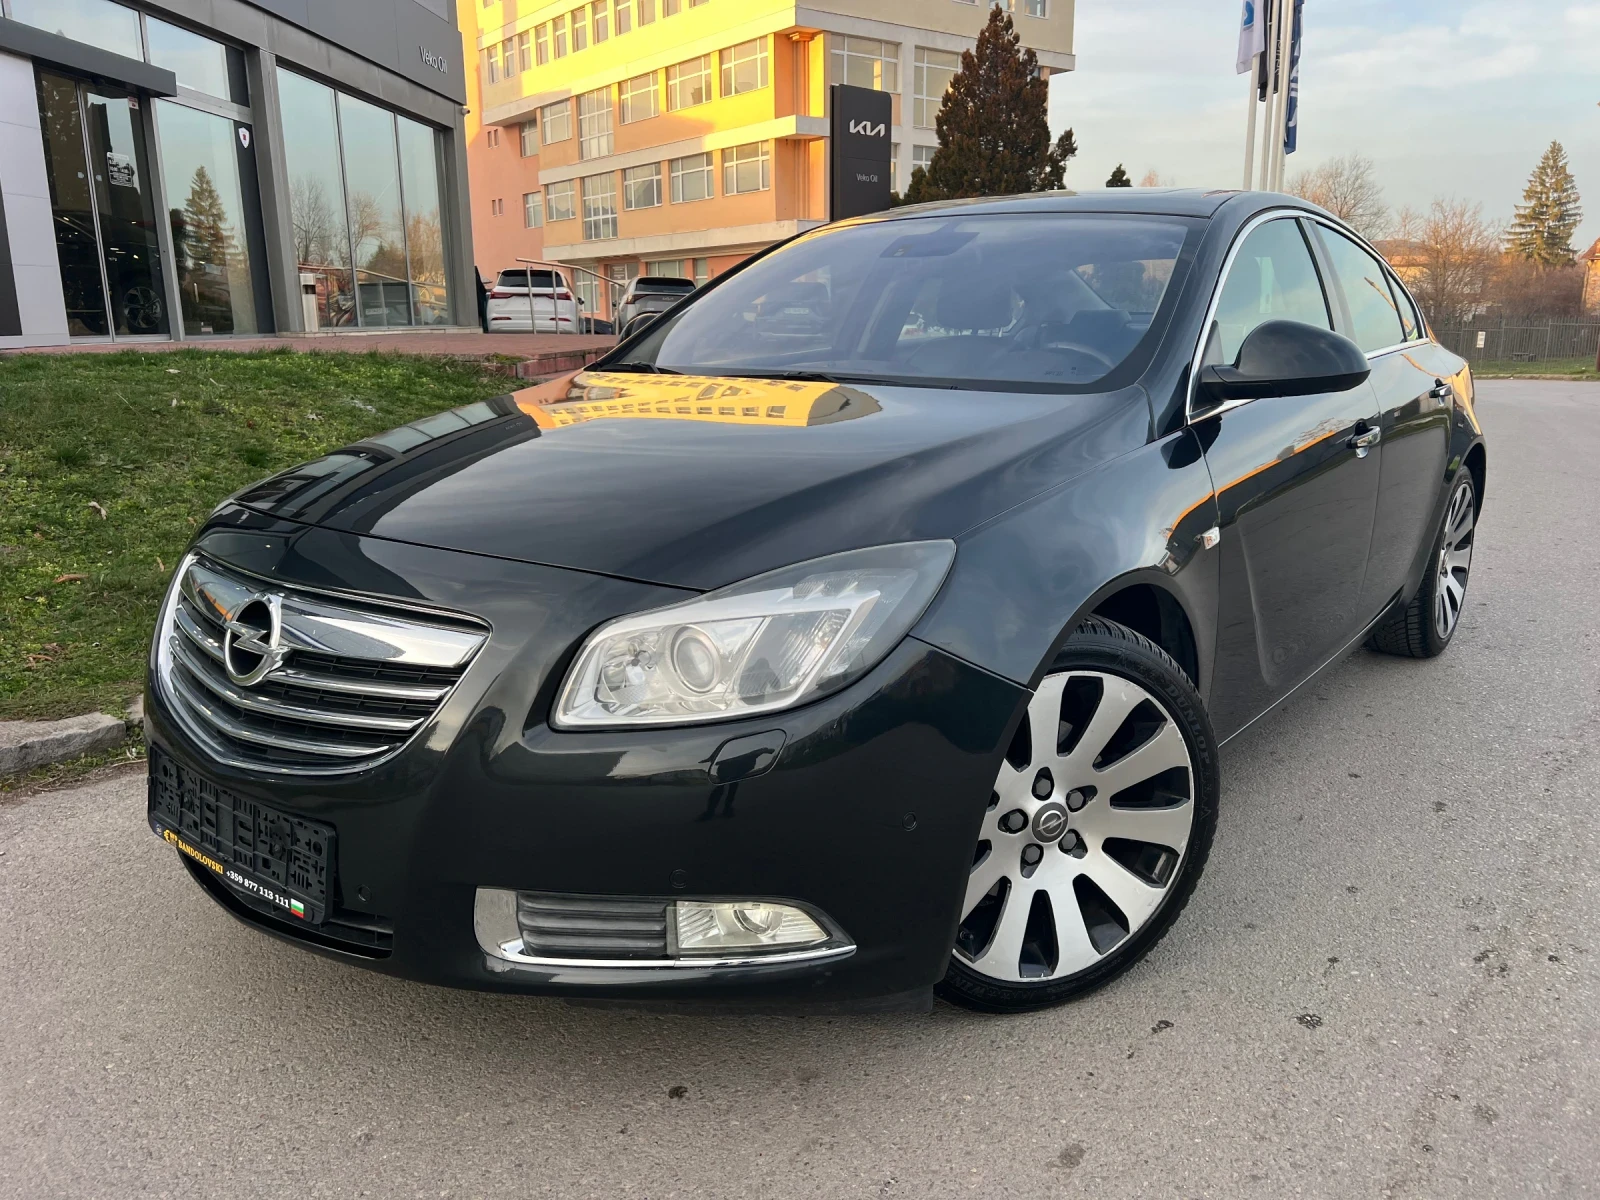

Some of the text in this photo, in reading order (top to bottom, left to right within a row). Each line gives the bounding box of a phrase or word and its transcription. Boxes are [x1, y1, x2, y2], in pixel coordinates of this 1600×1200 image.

[419, 46, 437, 68] Veko
[849, 119, 885, 137] KIA
[1165, 684, 1210, 764] DUNLOP
[178, 840, 290, 909] BANDOLOVSKI +359 877 113 111
